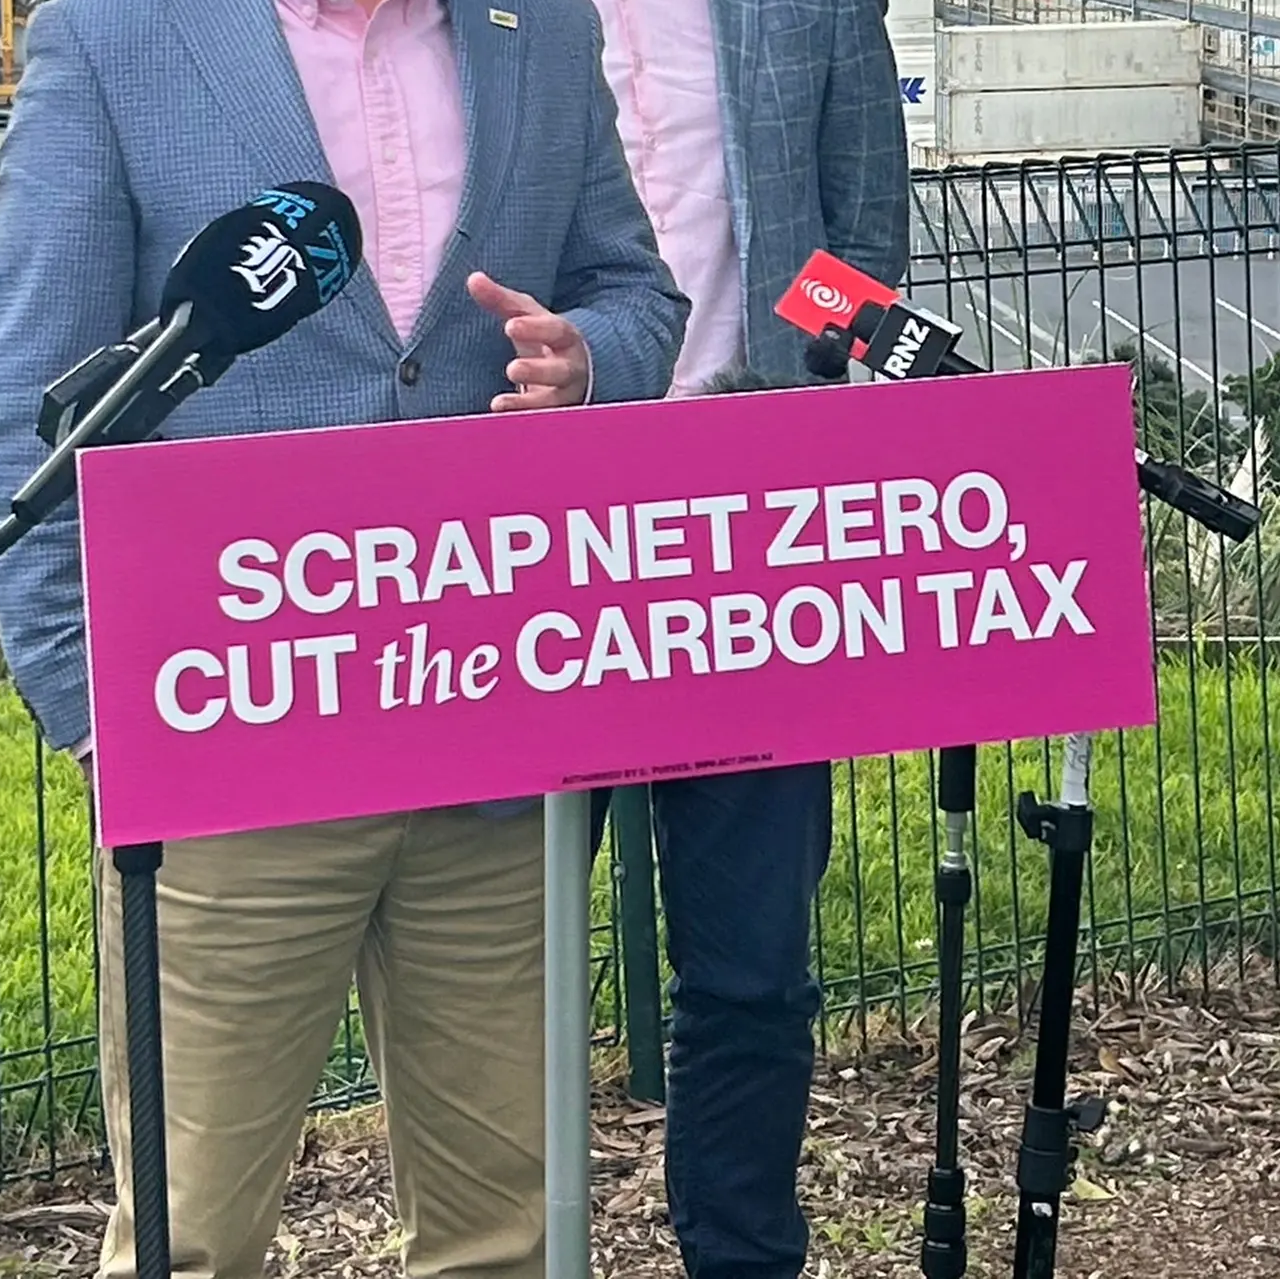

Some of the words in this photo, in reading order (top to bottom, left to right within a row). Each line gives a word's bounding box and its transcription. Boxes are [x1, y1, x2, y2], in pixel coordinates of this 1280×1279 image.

[883, 317, 931, 379] RNZ
[219, 514, 551, 621] SCRAP
[566, 493, 748, 587] NET
[764, 471, 1027, 567] ZERO,
[154, 633, 357, 733] CUT
[375, 623, 501, 710] the
[515, 578, 905, 692] CARBON
[916, 559, 1096, 649] TAX
